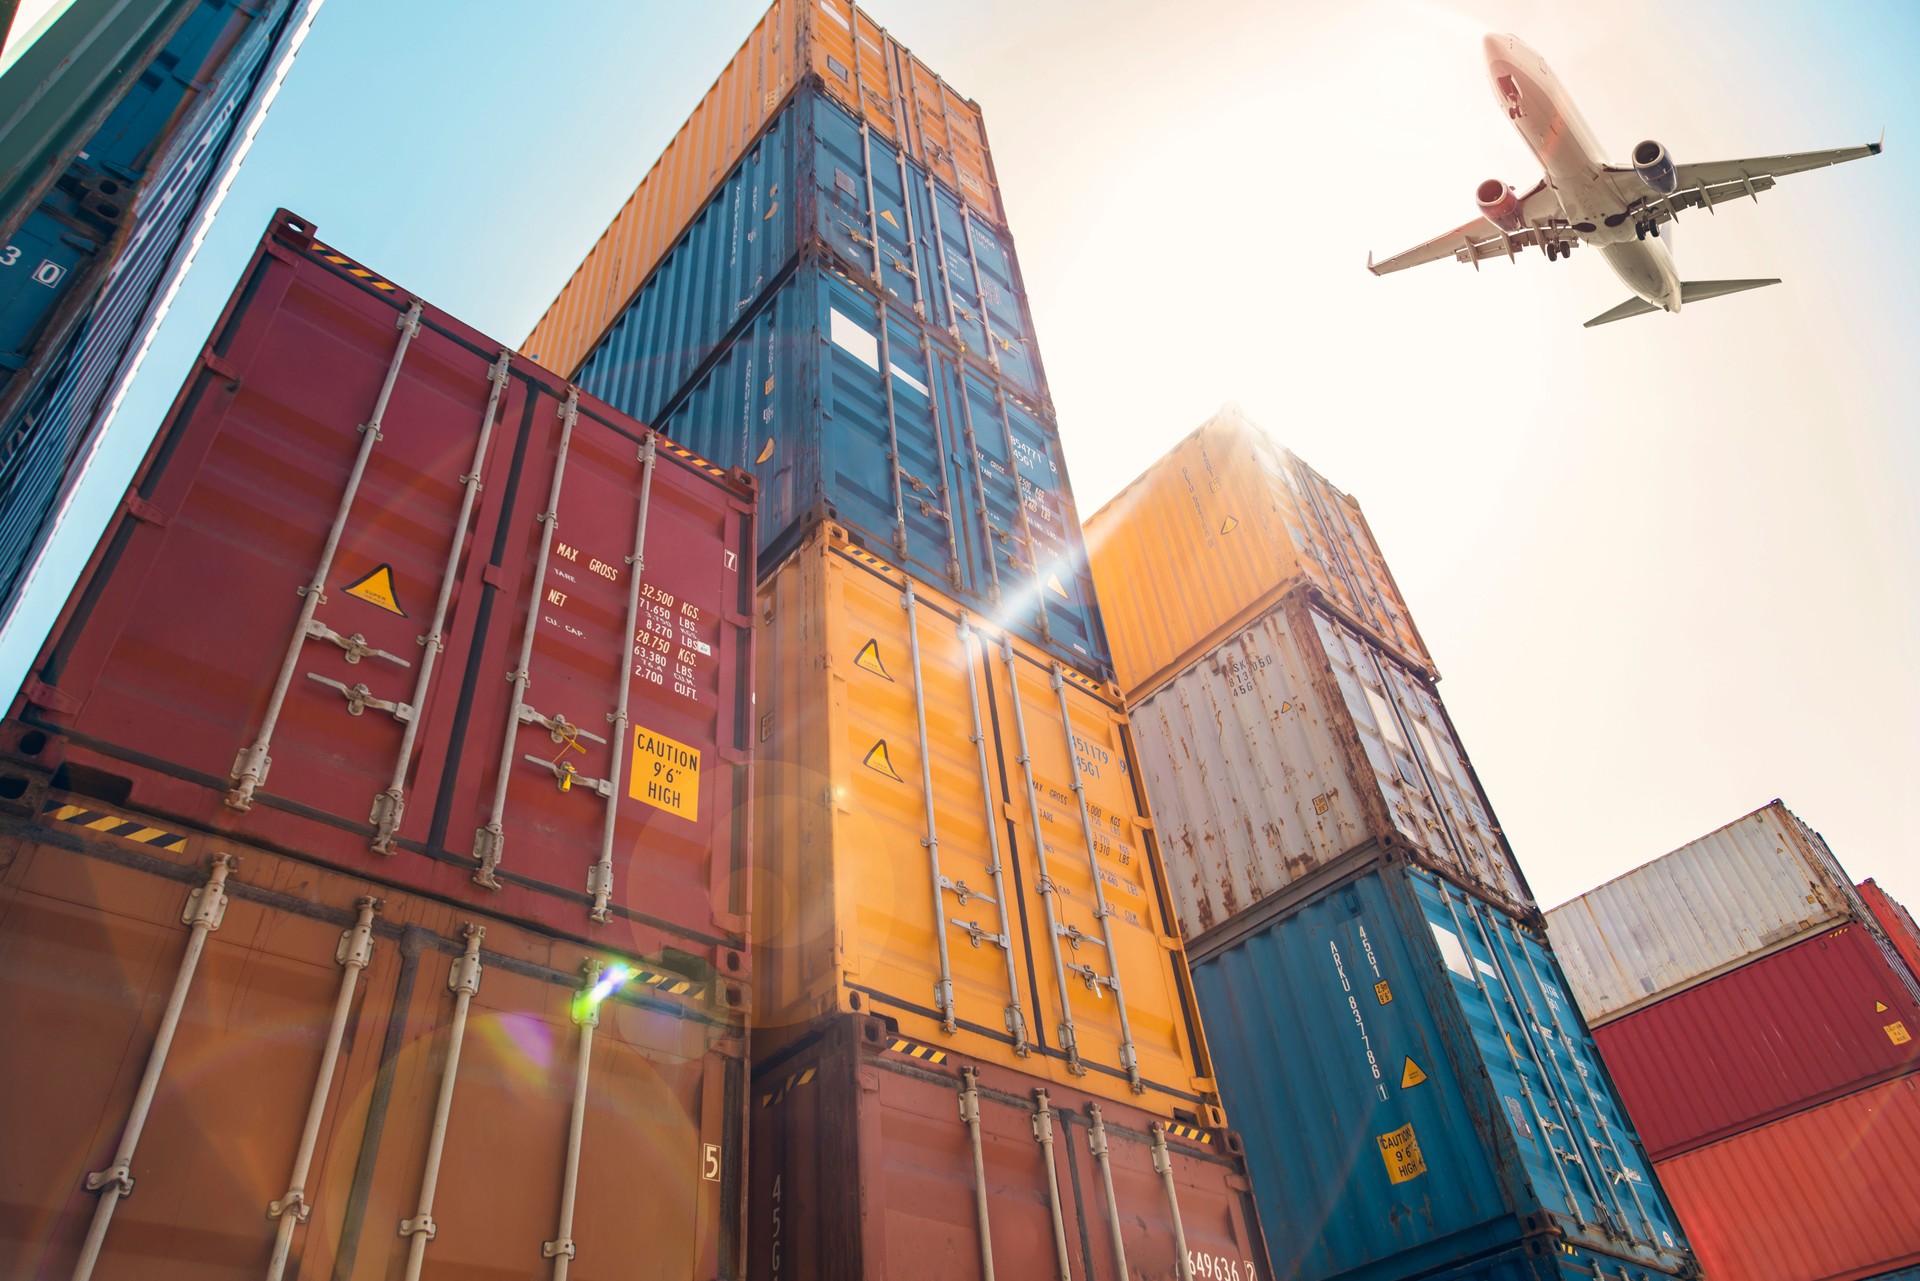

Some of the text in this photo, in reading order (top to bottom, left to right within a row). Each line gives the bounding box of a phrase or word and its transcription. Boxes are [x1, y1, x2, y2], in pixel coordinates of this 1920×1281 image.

[36, 262, 62, 286] 0
[553, 568, 577, 584] TARE
[556, 542, 699, 621] MAX GROSS 32.500 KGS.
[545, 616, 561, 628] CU.
[564, 624, 586, 640] CAP.
[547, 589, 567, 608] NET
[636, 629, 671, 654] 28.750
[677, 647, 697, 667] KGS.
[639, 597, 698, 634] 71.650 LBS.
[646, 619, 673, 640] 8.270
[634, 645, 695, 681] 63.380 LBS.
[634, 665, 663, 686] 2.700
[637, 733, 697, 772] CAUTION
[648, 780, 681, 809] HIGH
[1049, 789, 1068, 805] GROSS
[1110, 815, 1121, 828] KGS
[1039, 808, 1054, 824] TARE
[1118, 852, 1130, 866] LBS
[1359, 925, 1381, 978] 45G1
[1329, 940, 1388, 1100] ARKU 837786 1
[704, 1145, 720, 1180] 5
[1398, 1160, 1417, 1177] HIGH
